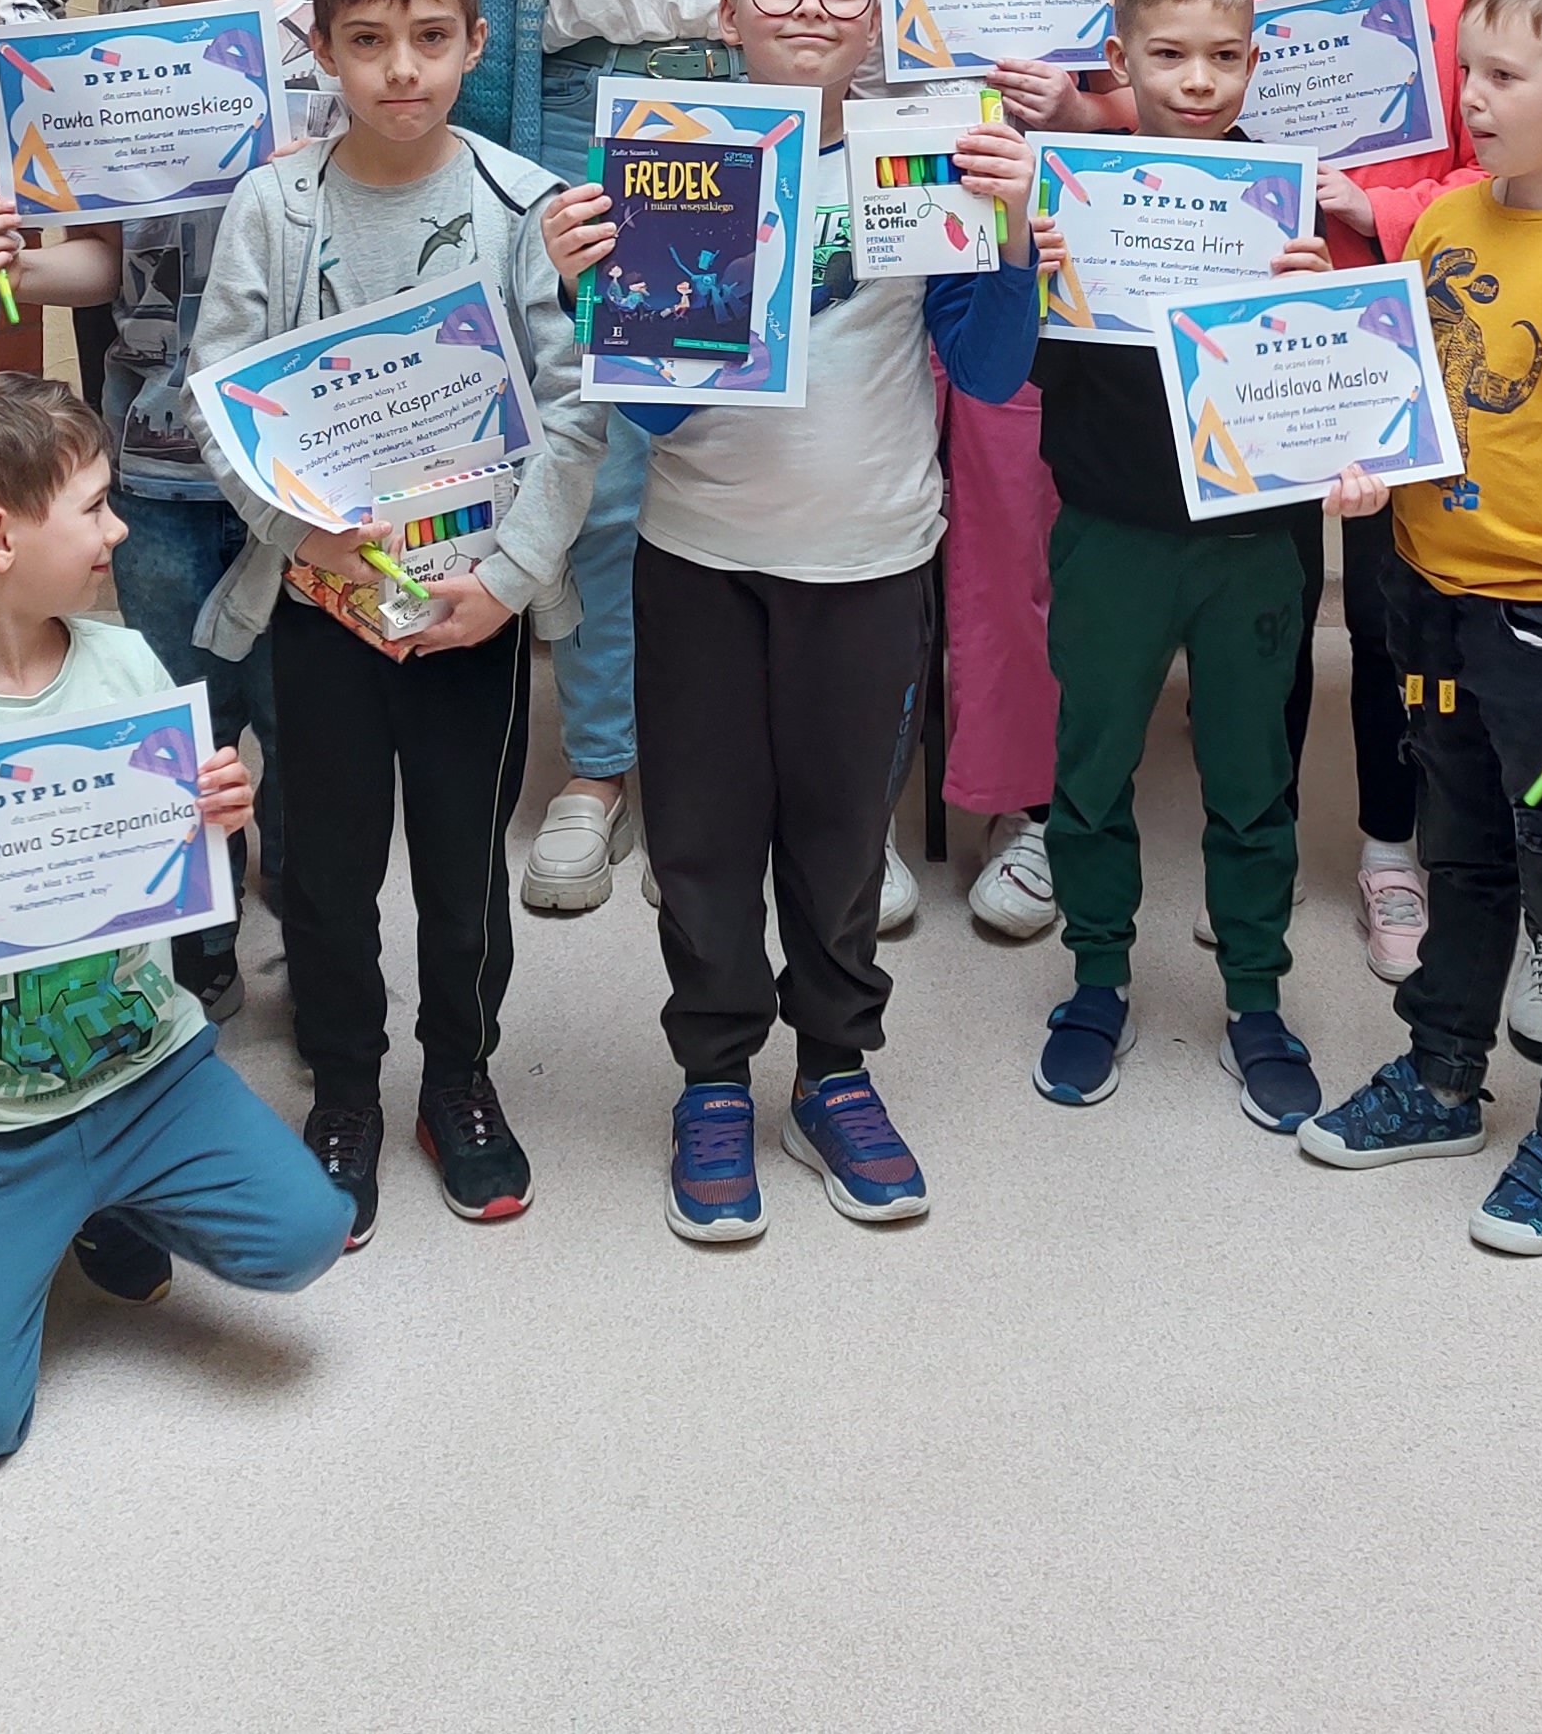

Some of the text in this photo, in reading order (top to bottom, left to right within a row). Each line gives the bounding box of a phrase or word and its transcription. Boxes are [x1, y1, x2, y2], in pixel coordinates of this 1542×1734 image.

[1259, 35, 1350, 63] DYPLOM
[84, 63, 192, 86] DYPLOM
[1258, 72, 1353, 100] Kaliny Ginter
[42, 96, 253, 131] Pawła Romanowskiego
[624, 160, 721, 200] FREDEK
[644, 202, 734, 213] i miara wszystkiego
[864, 202, 906, 216] School
[1123, 194, 1227, 212] DYPLOM
[865, 218, 917, 230] & Office
[866, 235, 905, 244] PERMANENT
[867, 245, 894, 254] MARKER
[1110, 229, 1244, 256] Tomasza Hirt
[868, 255, 901, 263] 10 colours
[1256, 331, 1348, 356] DYPLOM
[311, 352, 423, 399] DYPLOM
[1236, 366, 1388, 404] Vladislava Maslov
[375, 387, 395, 401] klasy
[397, 380, 408, 390] II
[462, 395, 483, 409] klasy
[299, 371, 482, 451] Szymona Kasprzaka
[332, 452, 371, 473] Szkolnym
[416, 409, 482, 443] Matematycznym
[50, 801, 196, 848] Szczepaniaka
